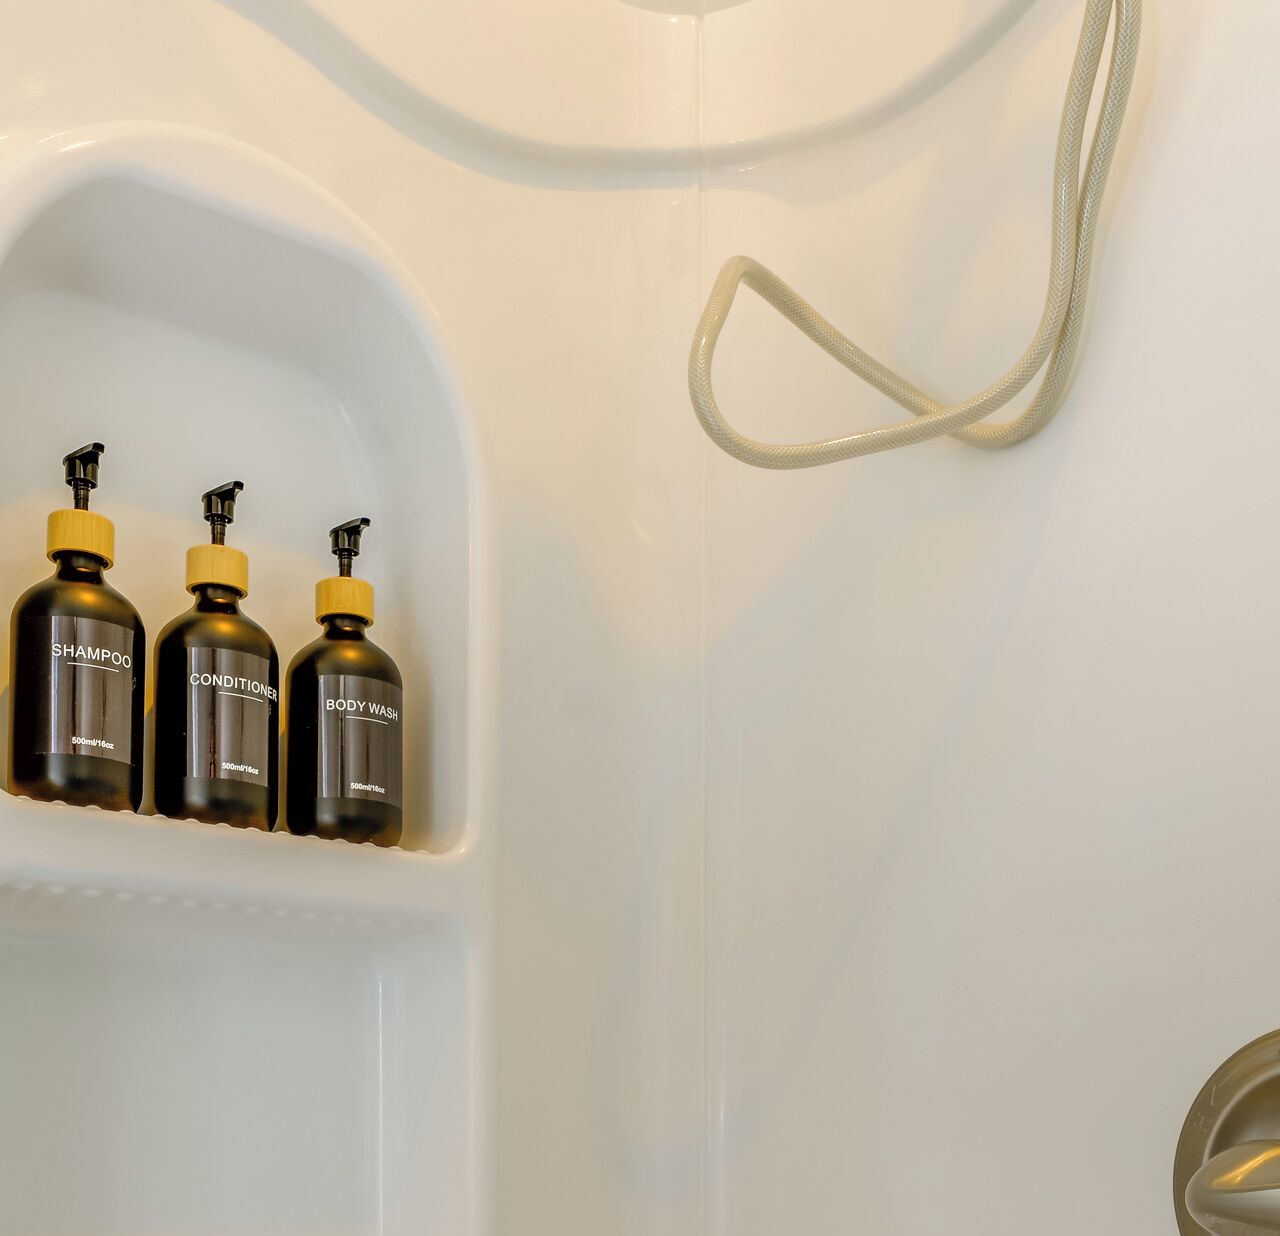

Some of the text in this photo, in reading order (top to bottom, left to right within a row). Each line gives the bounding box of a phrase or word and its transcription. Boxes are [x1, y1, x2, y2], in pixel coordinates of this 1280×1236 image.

[52, 643, 132, 669] SHAMPOO
[189, 673, 278, 702] CONDITIONER
[326, 699, 398, 722] BODY WASH
[72, 736, 115, 750] 500ml/16oz
[222, 762, 260, 775] 500ml/16oz
